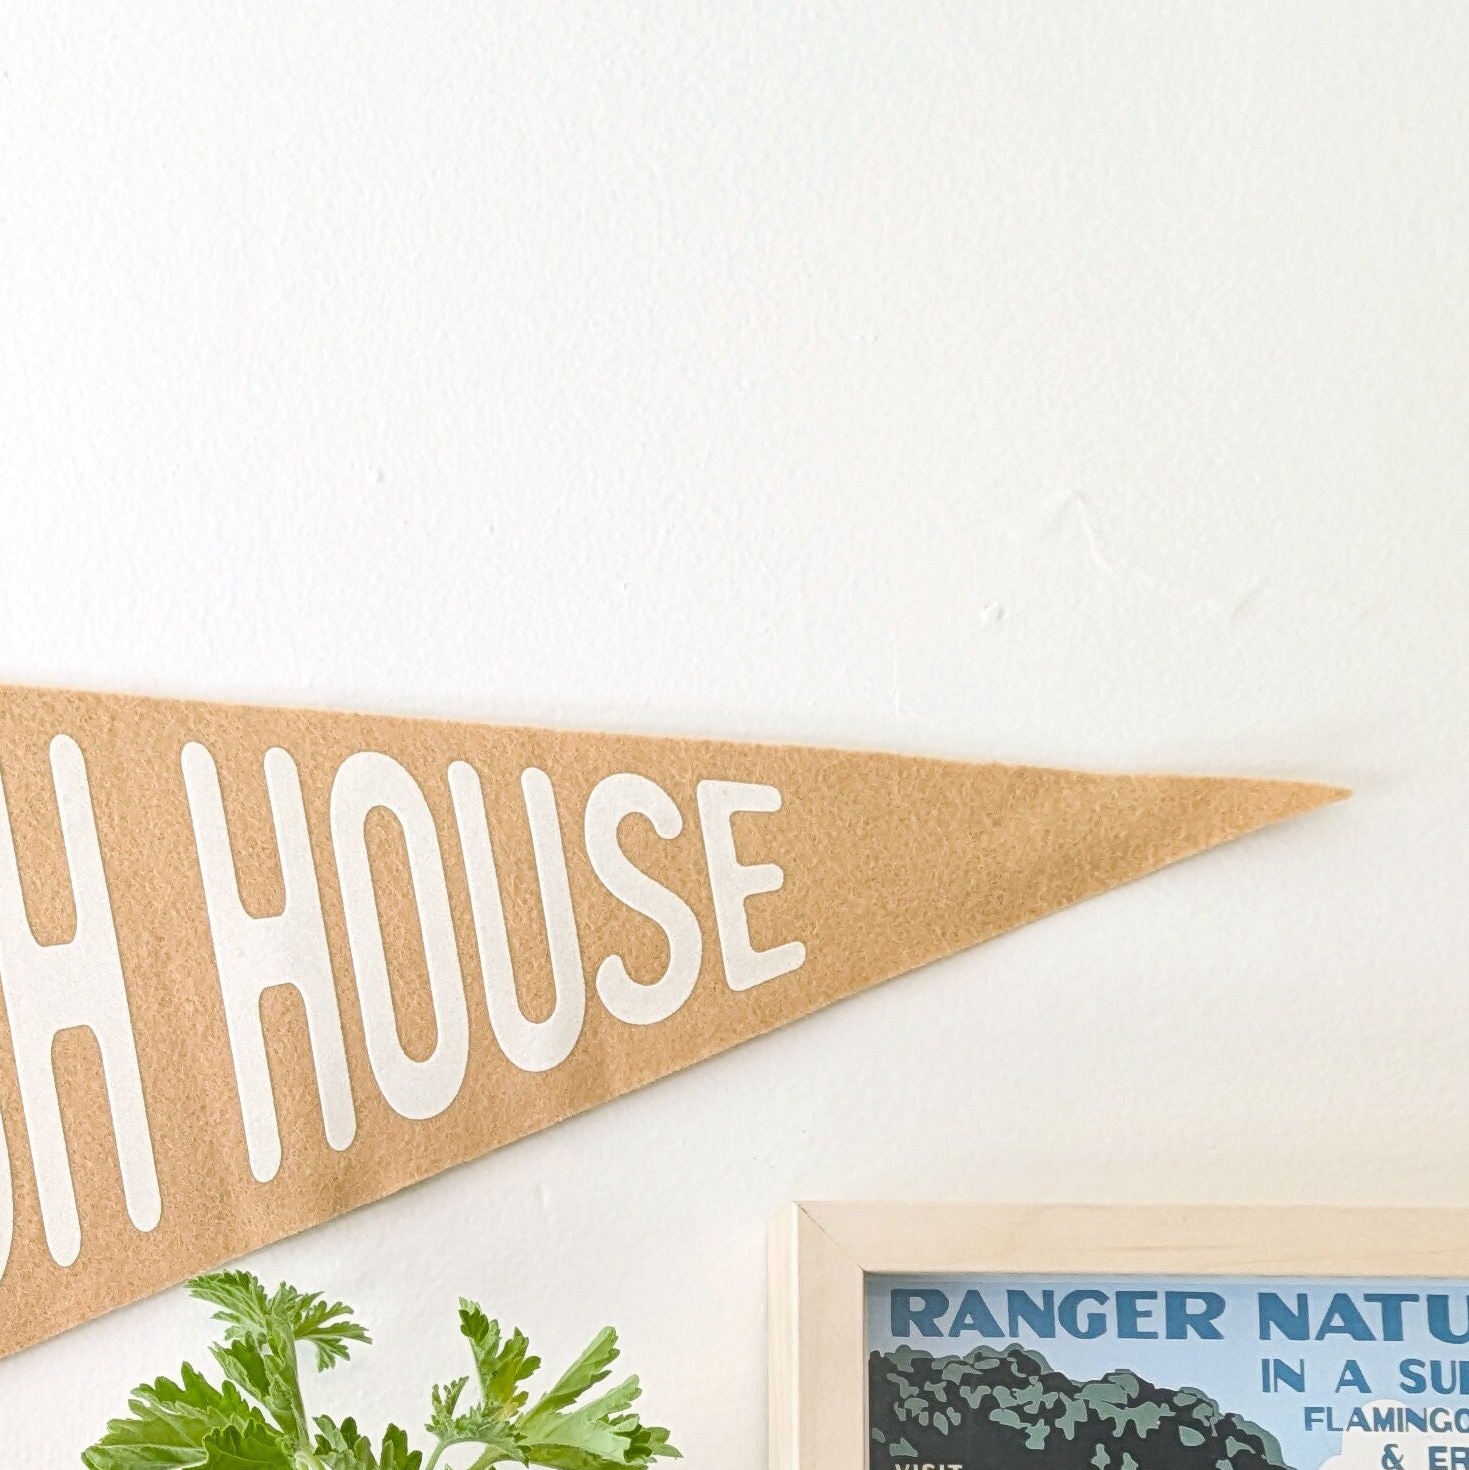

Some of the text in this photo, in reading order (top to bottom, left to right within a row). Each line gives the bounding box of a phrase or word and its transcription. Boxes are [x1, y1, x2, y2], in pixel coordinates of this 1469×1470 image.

[181, 741, 806, 1183] HOUSE
[890, 1288, 1469, 1345] RANGER NATU
[1261, 1358, 1305, 1393] IN
[1335, 1359, 1372, 1393] A
[1381, 1443, 1405, 1470] &
